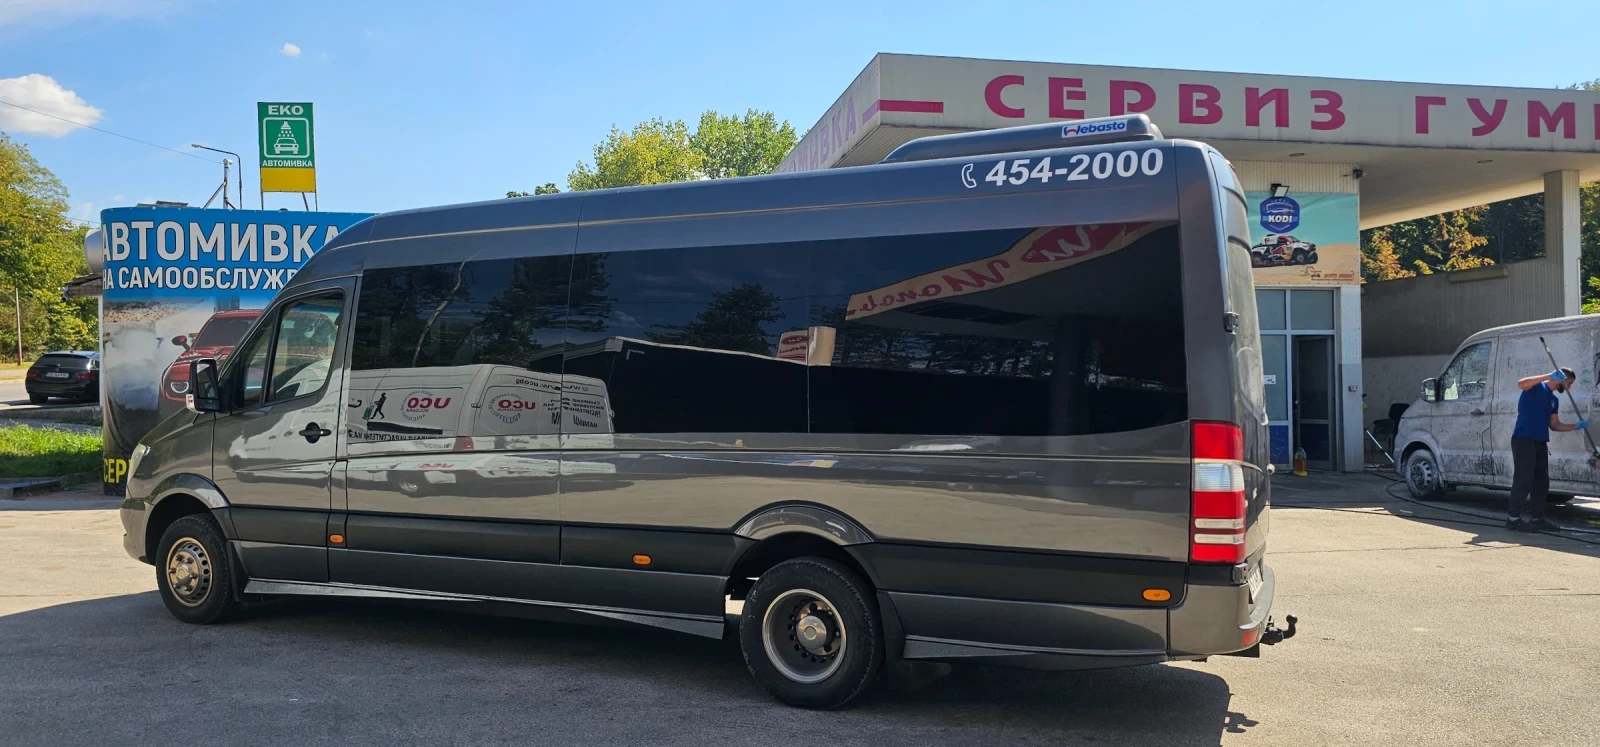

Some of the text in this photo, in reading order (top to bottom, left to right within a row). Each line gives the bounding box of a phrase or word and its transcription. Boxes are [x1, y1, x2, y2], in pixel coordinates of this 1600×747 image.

[984, 74, 1346, 131] СЕРВИЗ
[1063, 121, 1126, 136] Webasto
[261, 159, 313, 167] АВТОМИВКА
[985, 148, 1164, 187] 454-2000
[1267, 214, 1293, 223] KODI
[104, 457, 131, 484] СЕР
